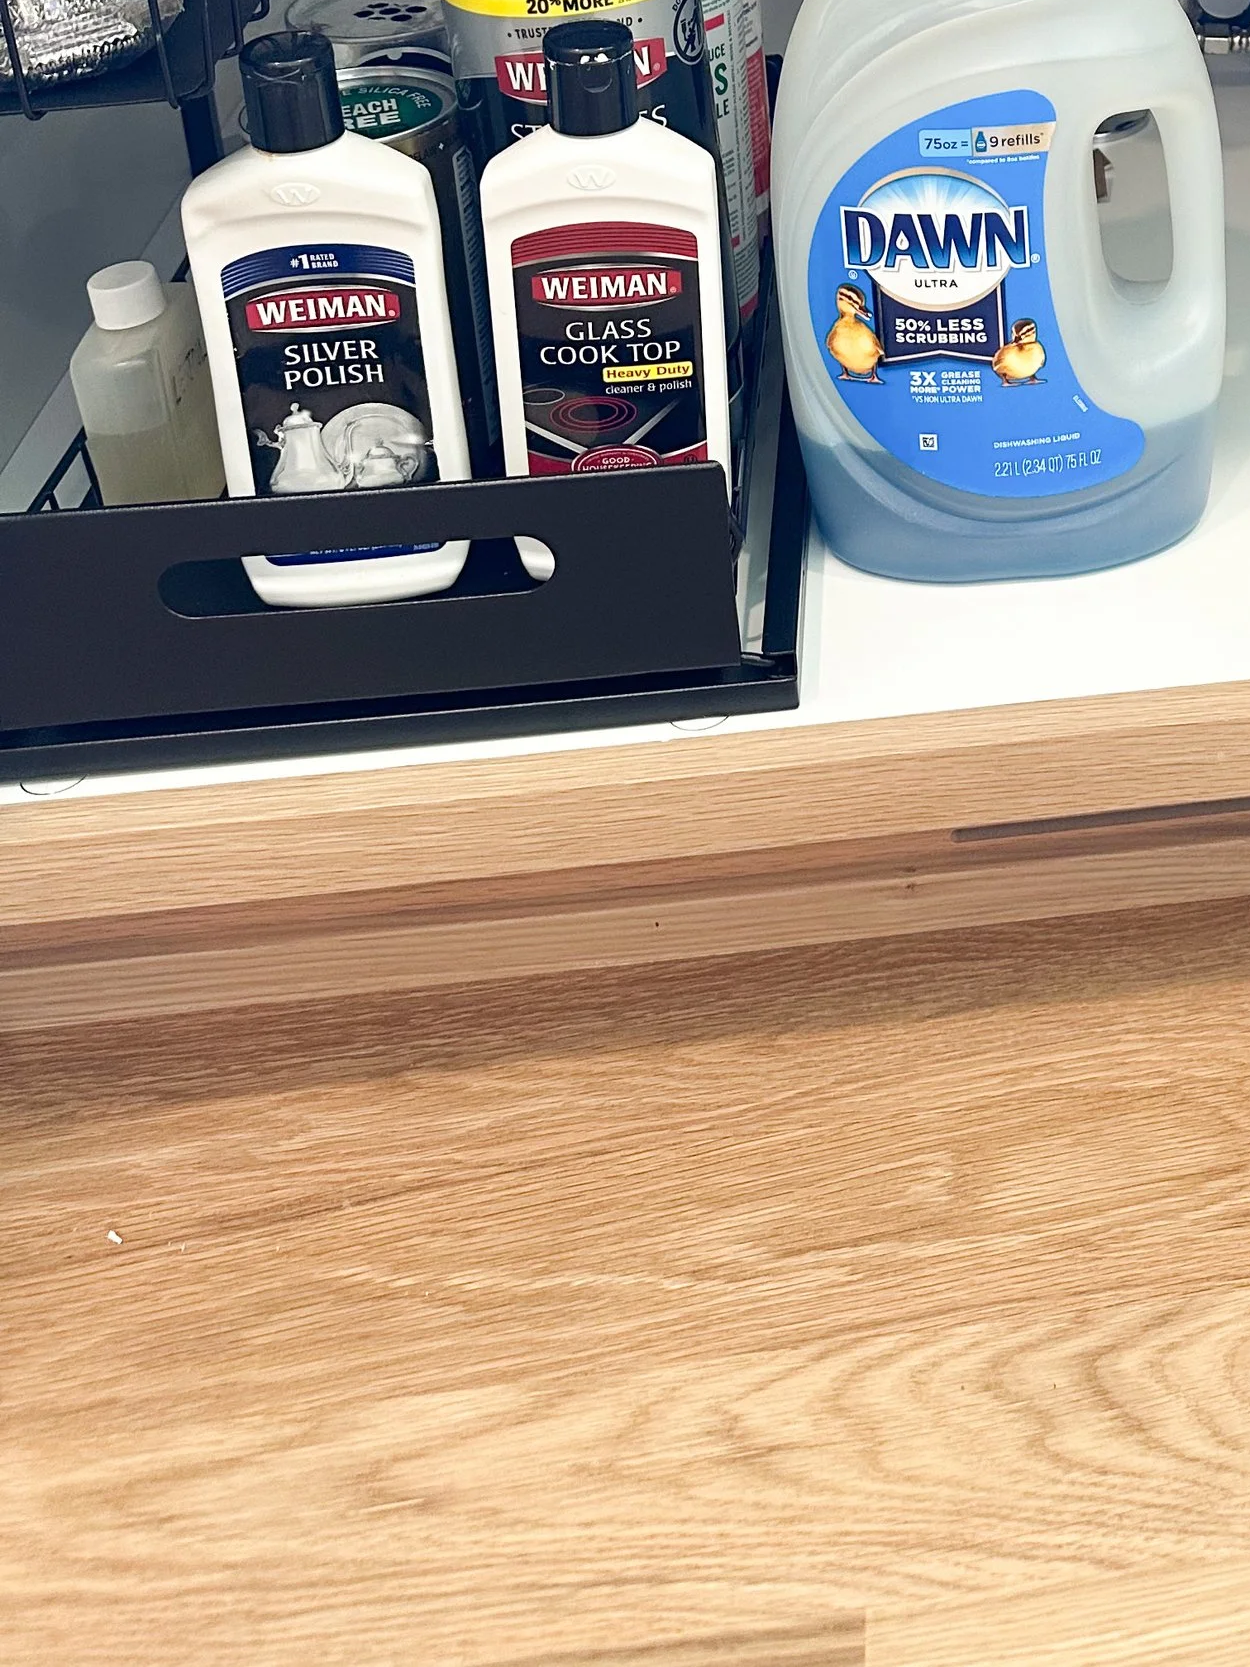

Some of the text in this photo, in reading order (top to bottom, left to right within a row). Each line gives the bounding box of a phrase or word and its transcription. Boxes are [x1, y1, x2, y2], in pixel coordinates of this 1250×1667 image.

[357, 86, 409, 97] SILICA
[341, 98, 398, 118] EACH
[341, 110, 401, 130] REE
[924, 137, 958, 150] 75oz
[989, 135, 999, 148] 9
[842, 207, 1029, 270] DAWN
[289, 253, 310, 270] #1
[309, 253, 336, 262] RATED
[310, 259, 339, 269] BRAND
[540, 272, 669, 301] WEIMAN
[914, 278, 959, 288] ULTRA
[255, 293, 387, 327] WEIMAN
[565, 317, 652, 342] GLASS
[894, 317, 985, 332] 50% LESS
[895, 332, 988, 344] SCRUBBING
[283, 338, 380, 366] SILVER
[539, 340, 681, 365] COOK TOP
[283, 363, 384, 390] POLISH
[606, 364, 691, 381] Heavy Duty
[909, 371, 938, 386] 3X
[941, 370, 981, 379] GREASE
[605, 380, 692, 395] cleaner & polish
[941, 378, 981, 386] CLEANING
[941, 385, 982, 394] POWER
[923, 395, 940, 404] NON
[939, 395, 962, 404] ULTRA
[961, 394, 983, 403] DAWN
[993, 432, 1081, 449] DISHWASHING LIQUID
[601, 456, 631, 465] GOOD
[1014, 461, 1021, 476] L
[1048, 453, 1064, 473] QT)
[1065, 453, 1077, 469] 75
[1078, 452, 1088, 468] FL
[1089, 448, 1102, 465] OZ
